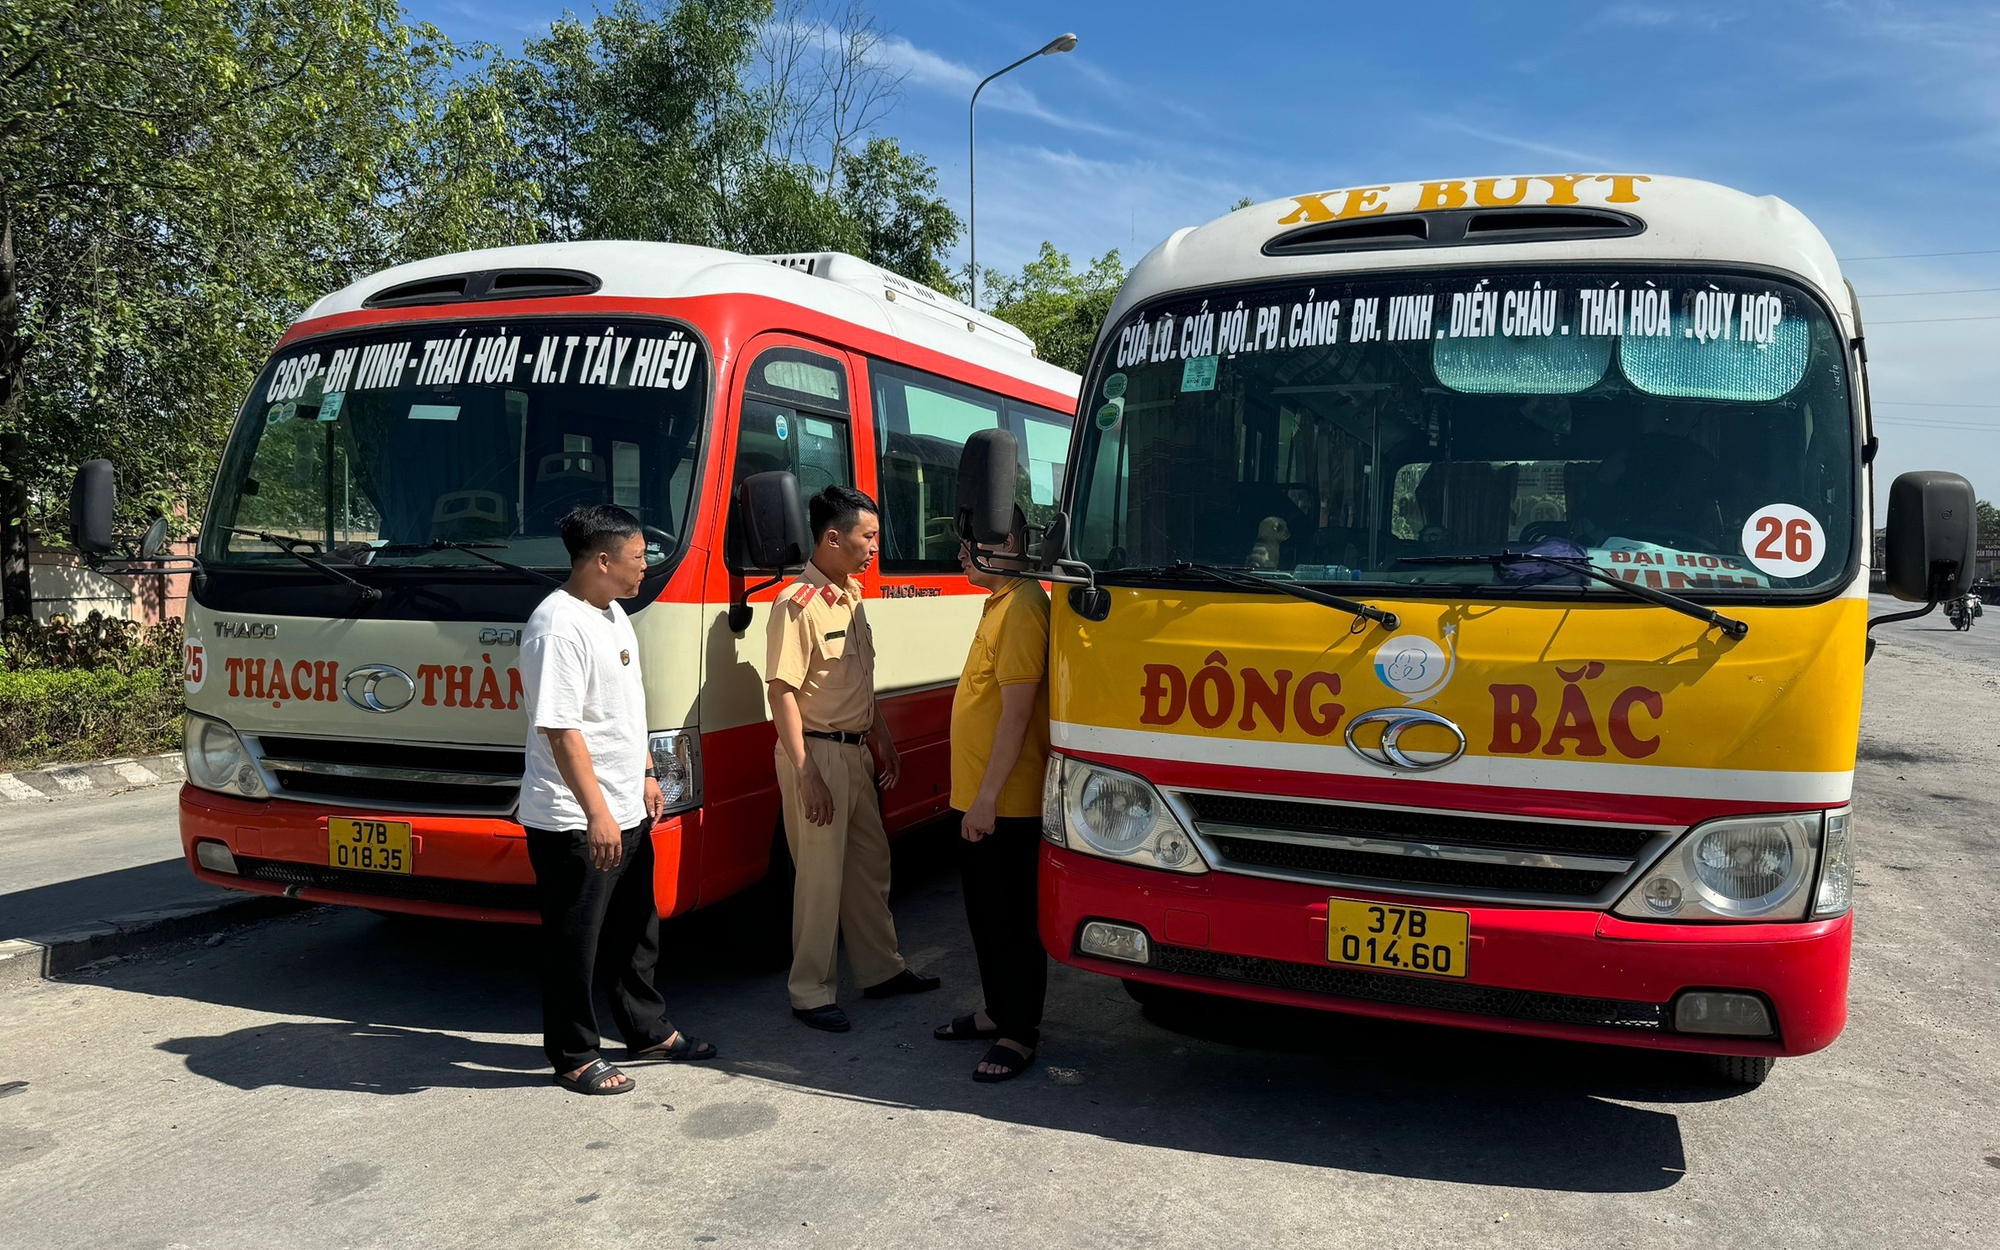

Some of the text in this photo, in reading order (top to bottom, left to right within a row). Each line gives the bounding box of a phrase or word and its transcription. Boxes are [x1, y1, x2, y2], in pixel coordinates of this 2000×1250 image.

[1277, 186, 1391, 225] XE
[1580, 281, 1625, 336] THÁI
[1630, 280, 1671, 337] HÒA
[354, 341, 412, 390] VINH
[579, 327, 632, 385] TÂY
[628, 331, 697, 391] HIẾU
[1754, 516, 1813, 562] 26
[214, 621, 278, 640] THACO
[184, 644, 204, 683] 25
[225, 657, 340, 709] THẠCH
[1140, 650, 1664, 760] ĐÔNG BẮC
[351, 821, 388, 845] 37B
[337, 844, 403, 871] 018.35
[1367, 906, 1428, 938] 37B
[1341, 934, 1452, 973] 014.60
